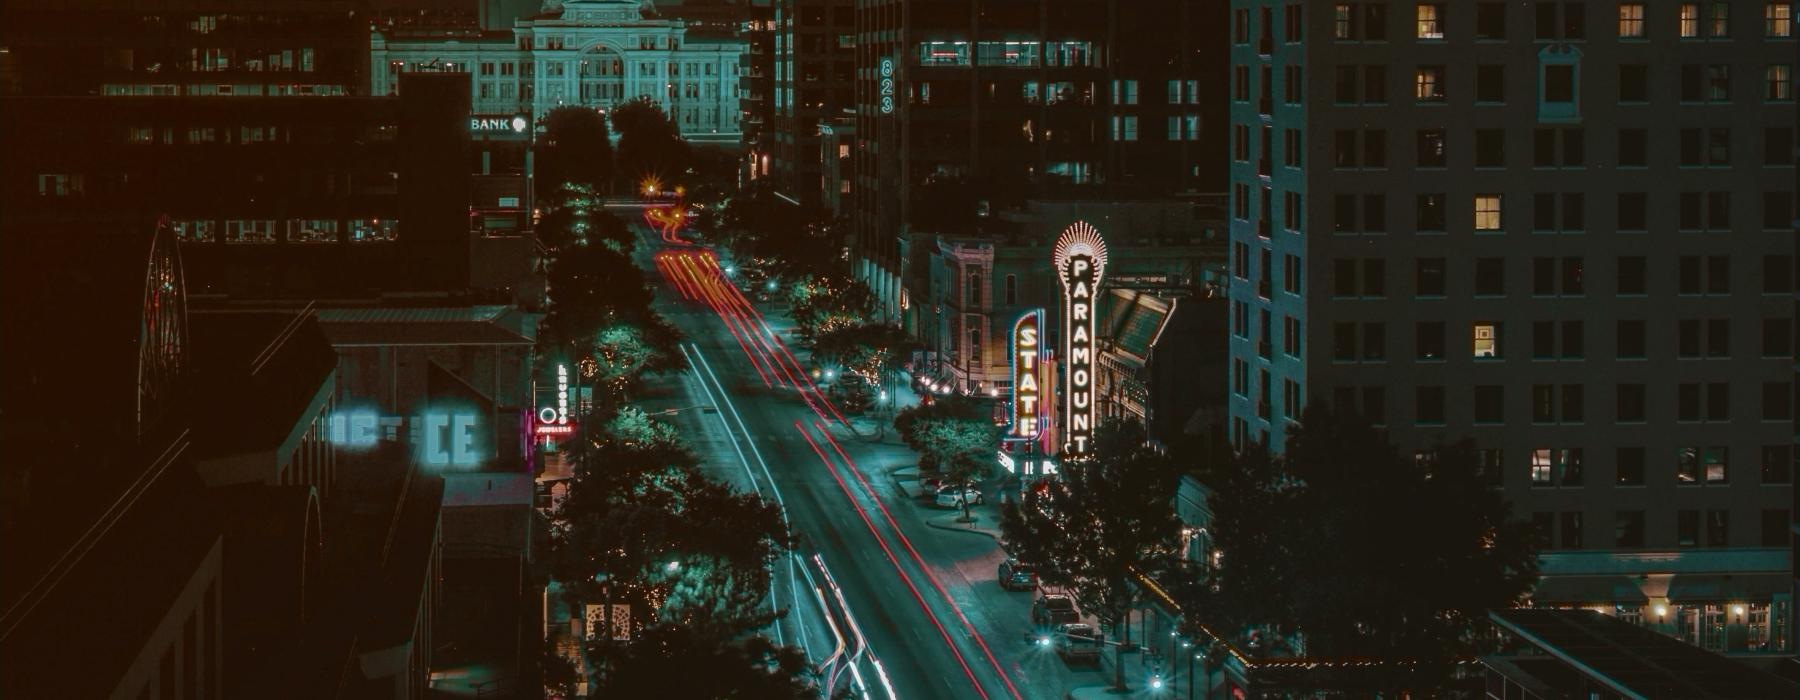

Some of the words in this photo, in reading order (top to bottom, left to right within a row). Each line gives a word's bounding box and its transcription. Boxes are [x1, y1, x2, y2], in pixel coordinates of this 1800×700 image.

[471, 119, 510, 130] BANK
[881, 60, 893, 113] 823
[1019, 328, 1038, 436] STATE
[1072, 259, 1090, 453] PARAMOUNT
